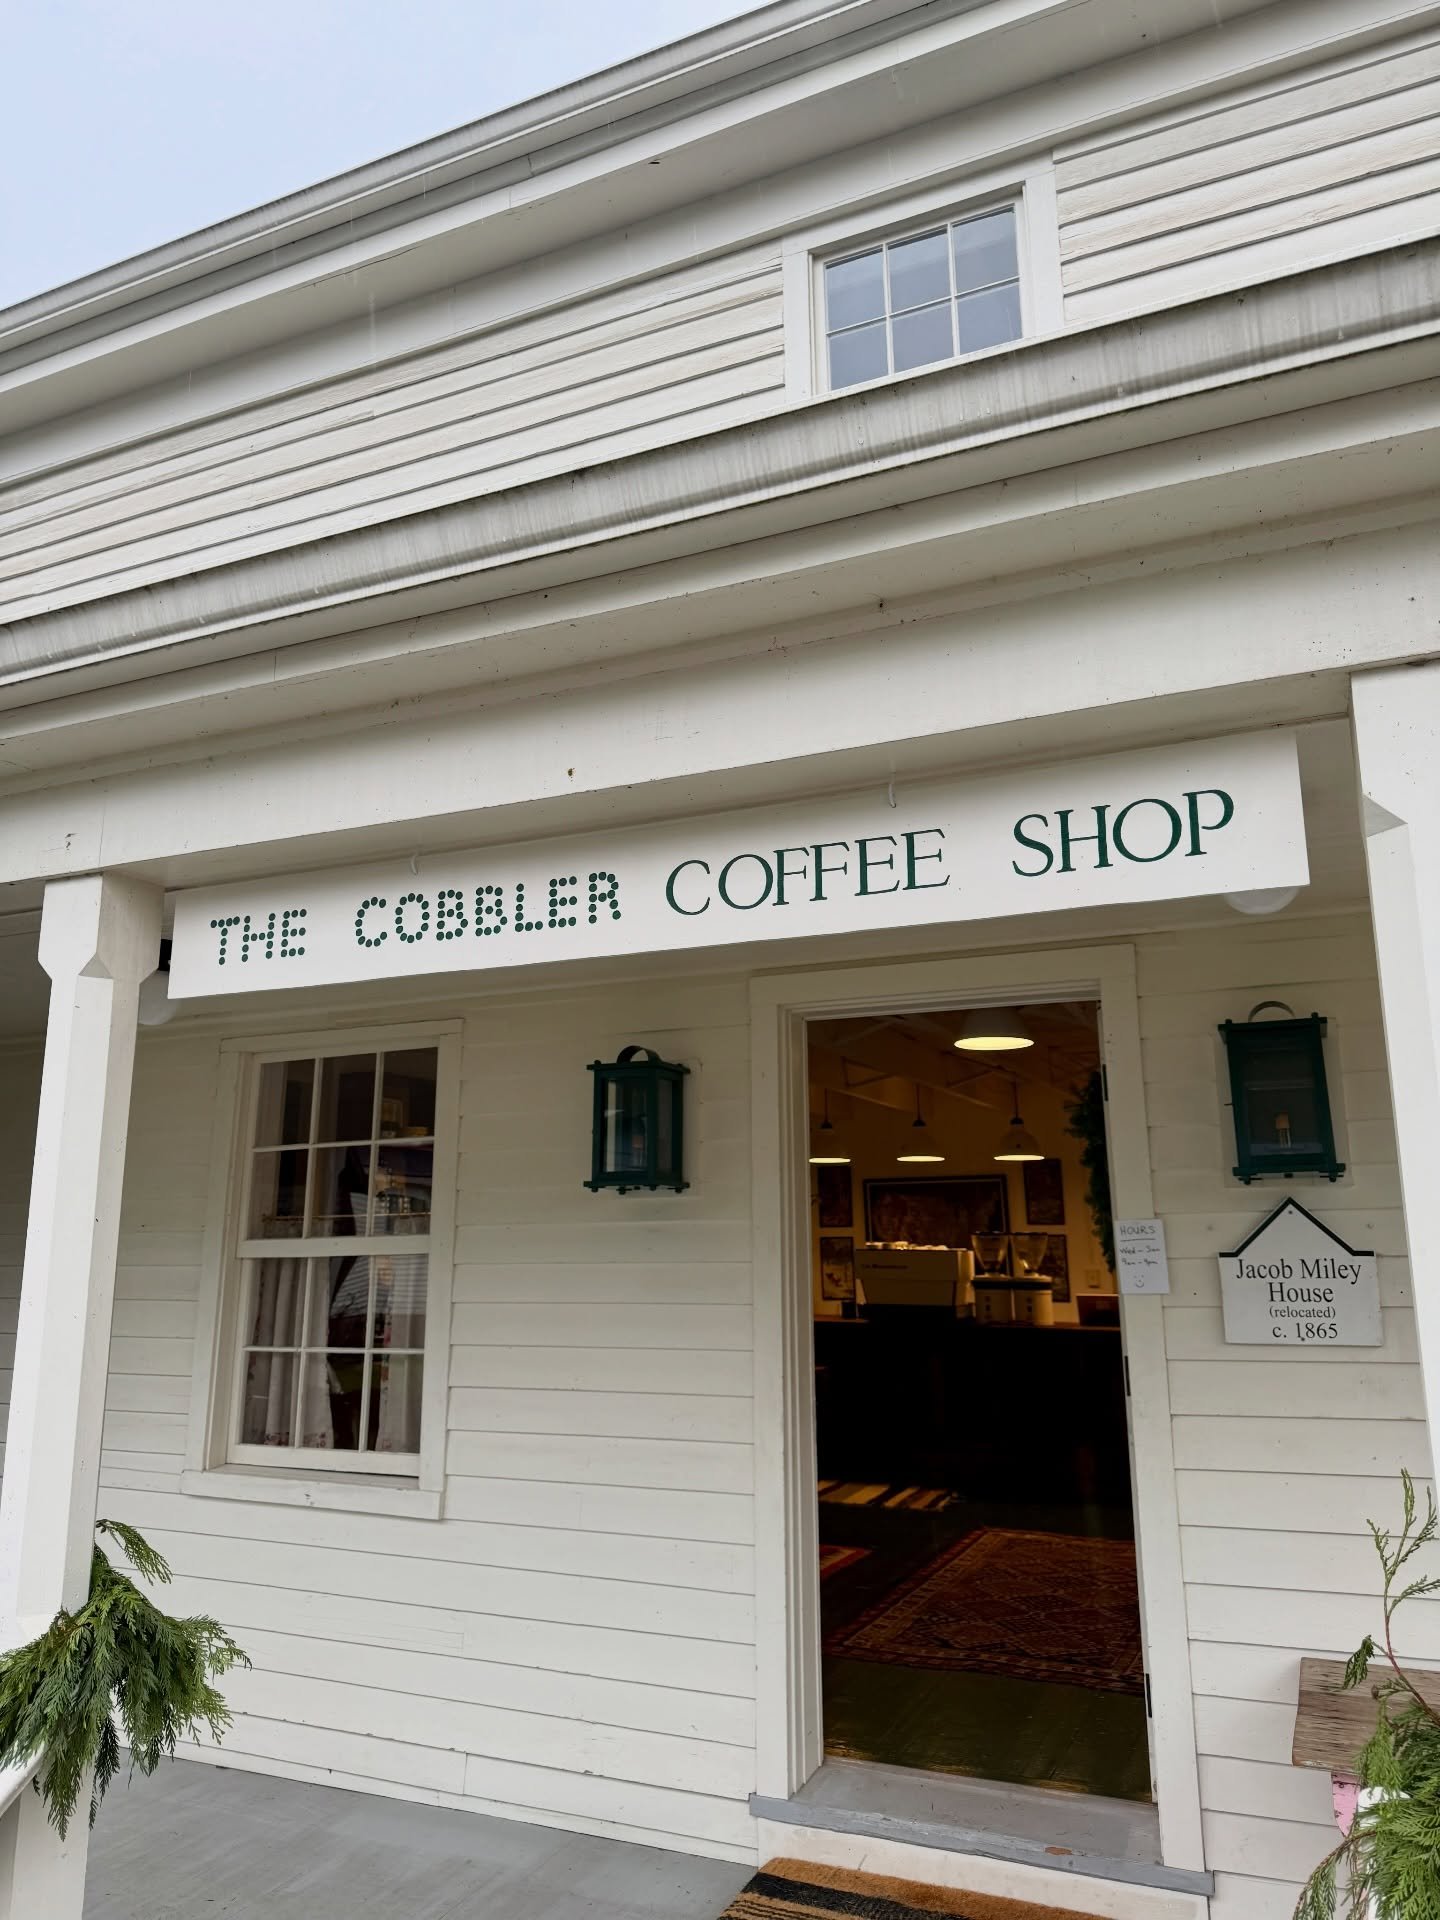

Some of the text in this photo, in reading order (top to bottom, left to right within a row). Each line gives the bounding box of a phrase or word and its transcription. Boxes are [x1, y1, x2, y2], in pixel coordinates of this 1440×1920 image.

[210, 788, 1235, 966] THE COBBLER COFFEE SHOP
[1119, 1224, 1156, 1236] HOURS
[1236, 1258, 1362, 1285] Jacob Miley
[1268, 1282, 1334, 1302] House
[1269, 1305, 1336, 1319] (relocated)
[1272, 1322, 1338, 1339] c. 1865
